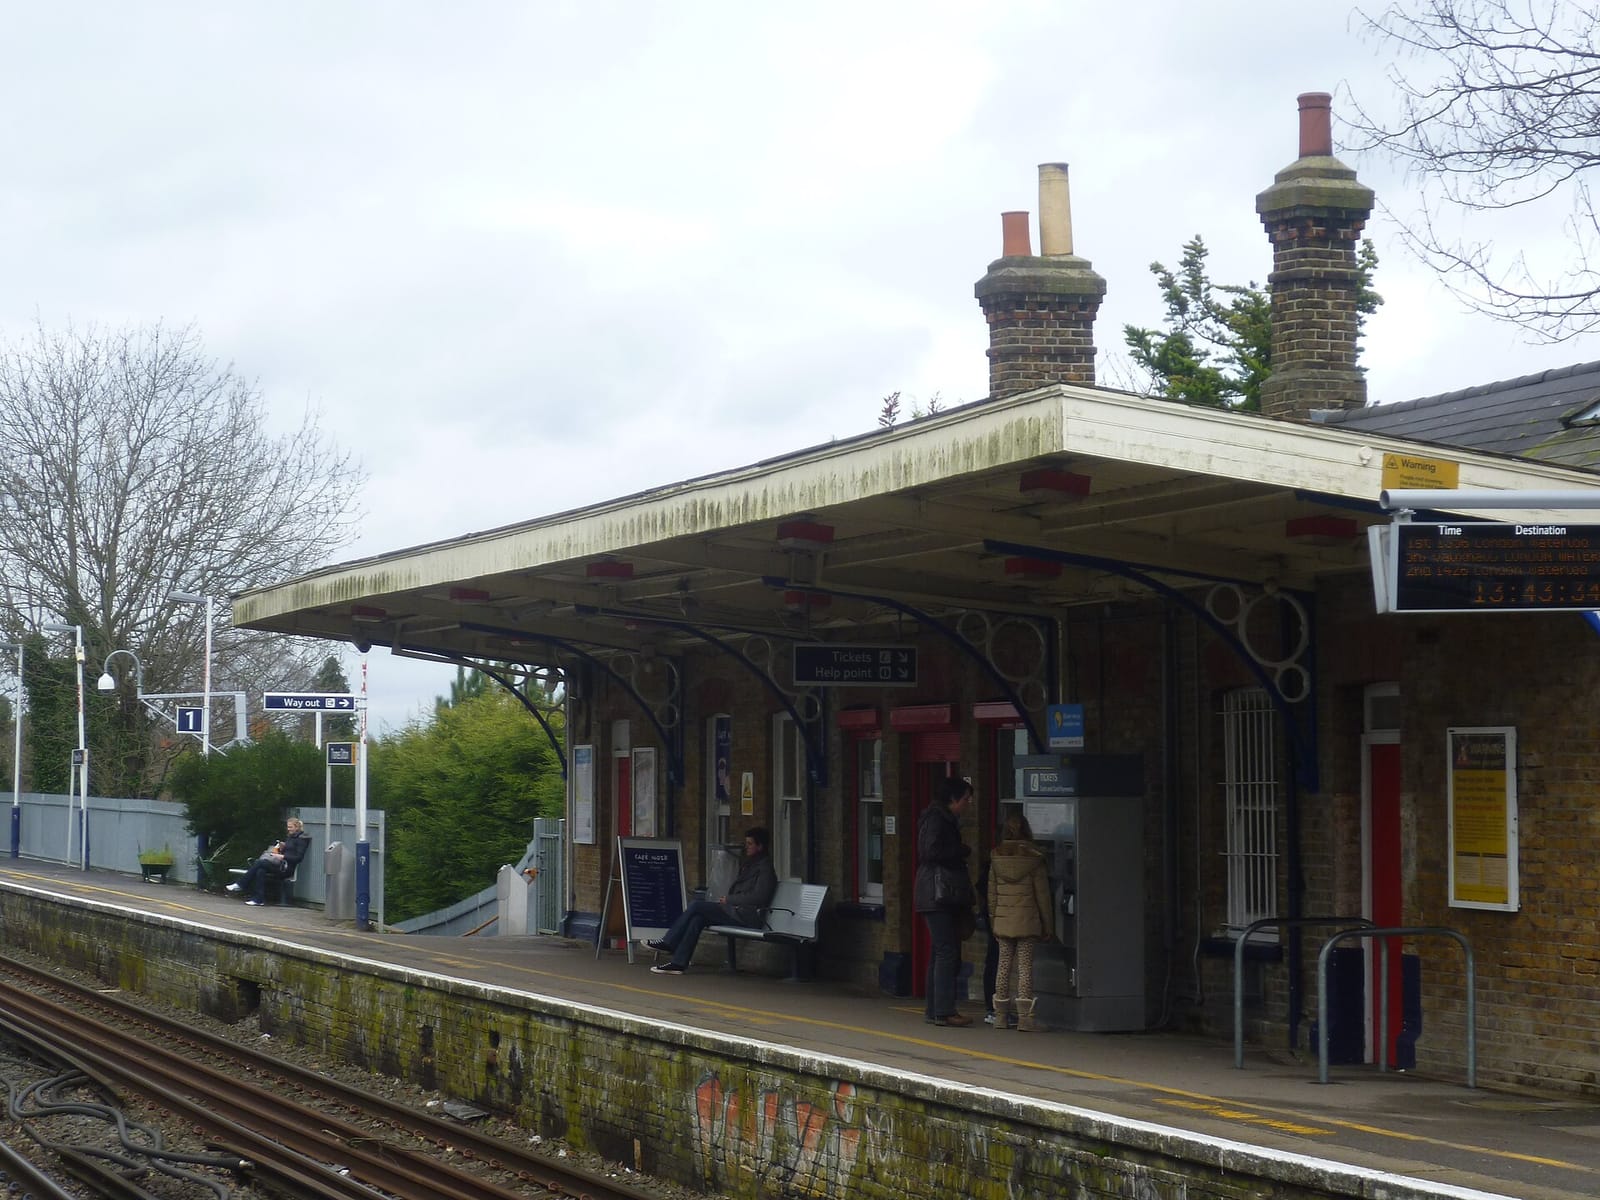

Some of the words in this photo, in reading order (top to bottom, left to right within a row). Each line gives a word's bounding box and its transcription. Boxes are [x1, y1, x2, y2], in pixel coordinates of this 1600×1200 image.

[1401, 458, 1437, 473] Warning
[1438, 525, 1462, 536] Time
[1515, 525, 1567, 536] Destination
[832, 650, 873, 663] Tickets
[815, 665, 841, 680] Help
[843, 667, 873, 680] point
[283, 698, 303, 709] Way
[305, 699, 320, 708] out
[185, 710, 194, 730] 1
